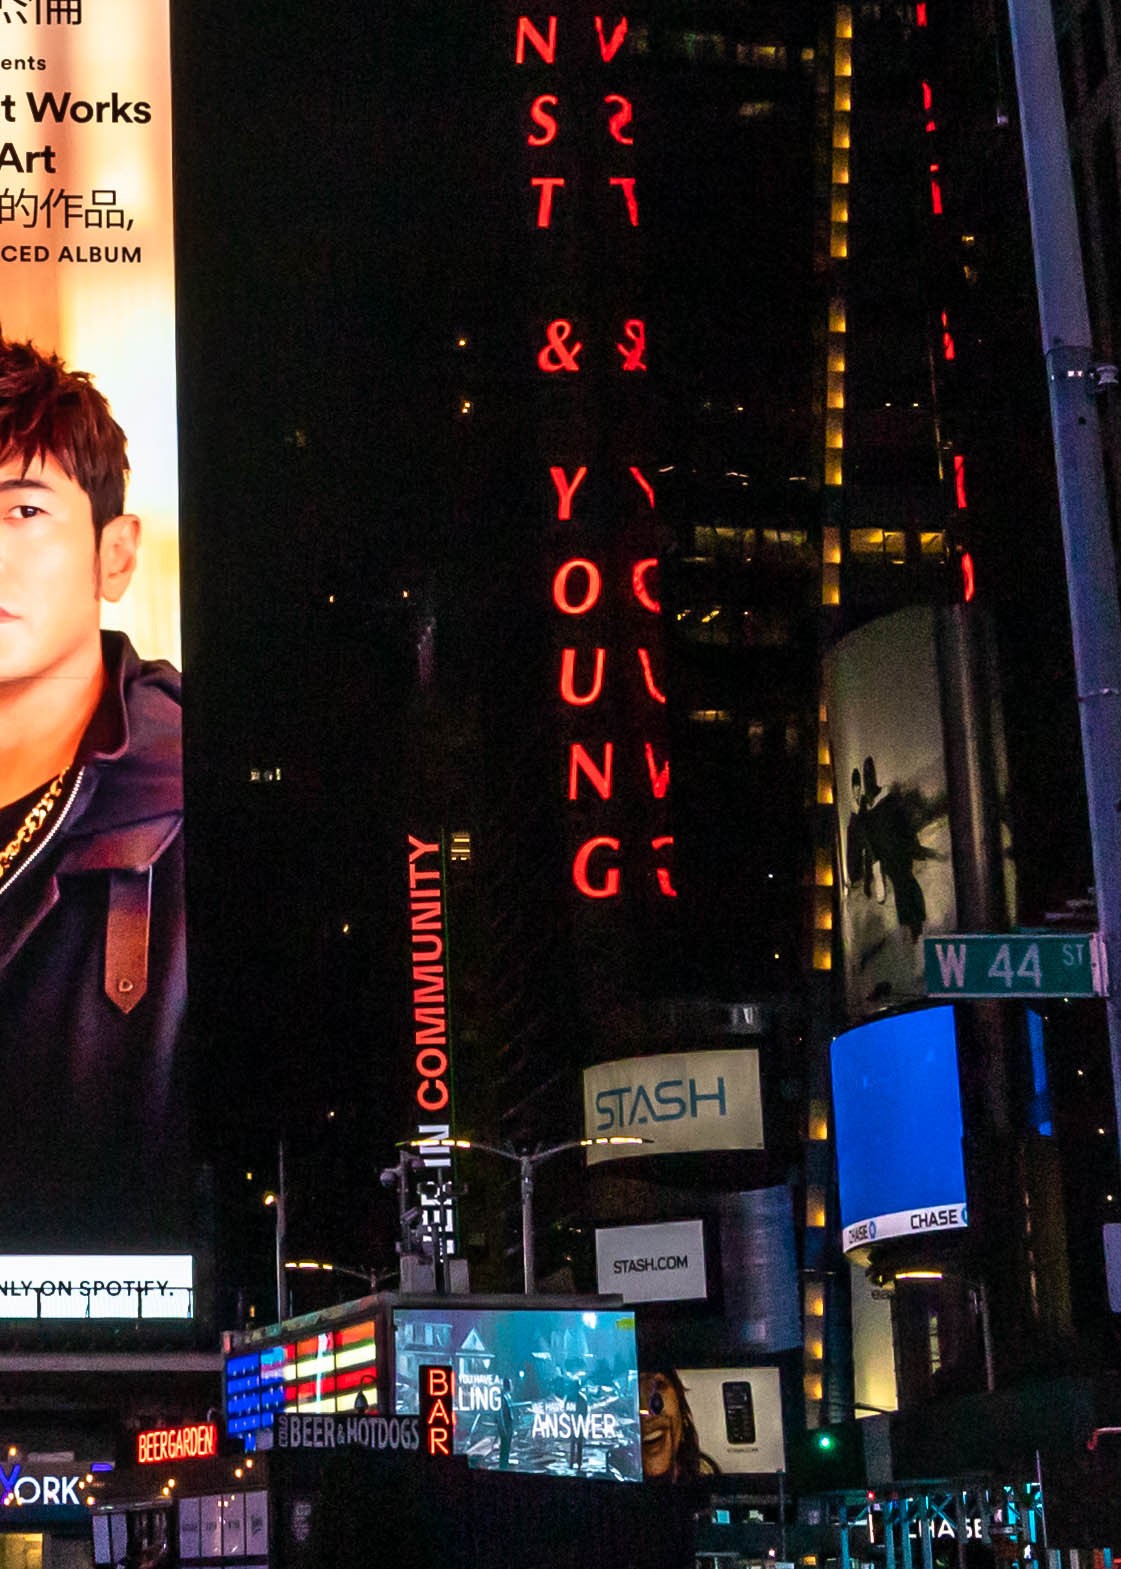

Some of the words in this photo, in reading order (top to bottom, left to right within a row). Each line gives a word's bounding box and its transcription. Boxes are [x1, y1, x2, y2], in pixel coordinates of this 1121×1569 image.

[26, 91, 152, 124] Works
[57, 246, 142, 264] ALBUM
[537, 319, 581, 371] &
[549, 465, 621, 898] YOUNG
[408, 834, 449, 1111] COMMUNITY
[935, 943, 967, 989] W
[987, 943, 1043, 989] 44
[1063, 943, 1084, 967] ST
[595, 1076, 727, 1131] STASH
[910, 1209, 959, 1230] CHASE
[613, 1255, 689, 1275] STASH.COM
[41, 1280, 72, 1297] ON
[79, 1281, 175, 1298] SPOTIFY.
[427, 1368, 451, 1456] BAR
[137, 1425, 216, 1464] BEERGARDEN
[290, 1417, 336, 1449] BEER
[336, 1424, 346, 1445] &
[347, 1417, 420, 1451] HOTDOGS
